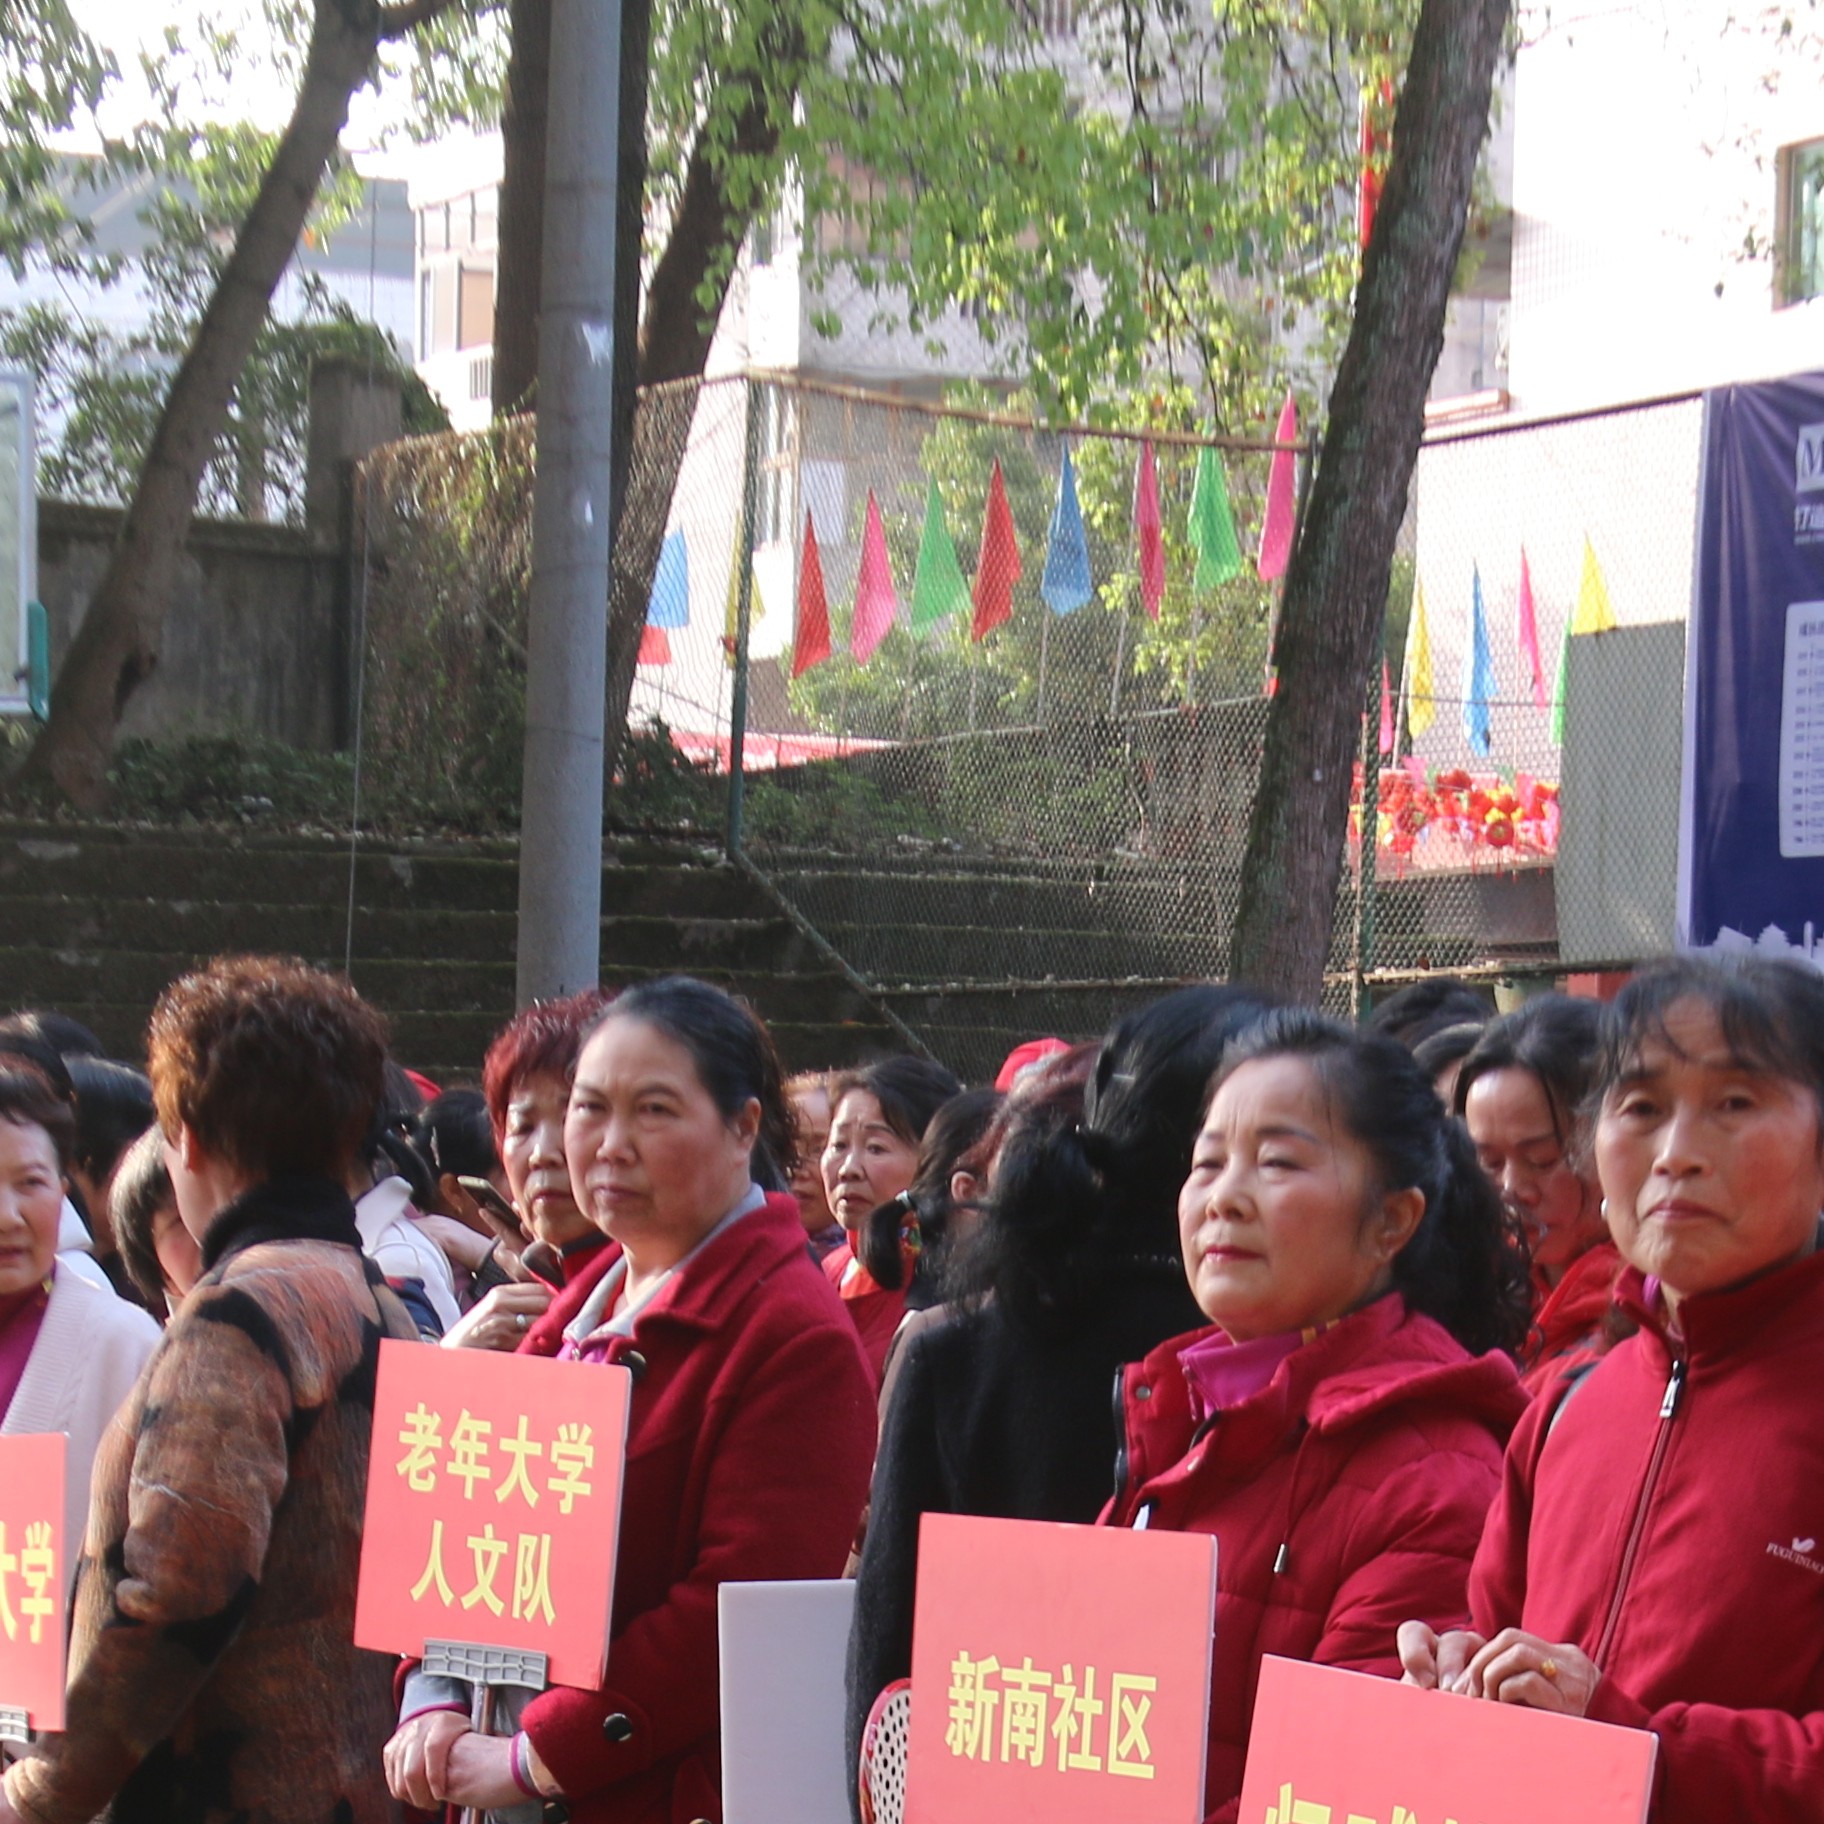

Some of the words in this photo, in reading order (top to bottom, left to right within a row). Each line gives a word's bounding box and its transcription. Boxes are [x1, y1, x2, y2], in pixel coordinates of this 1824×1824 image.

[396, 1402, 595, 1515] 老年大学
[409, 1518, 558, 1627] 人文队
[944, 1650, 1158, 1781] 新南社区
